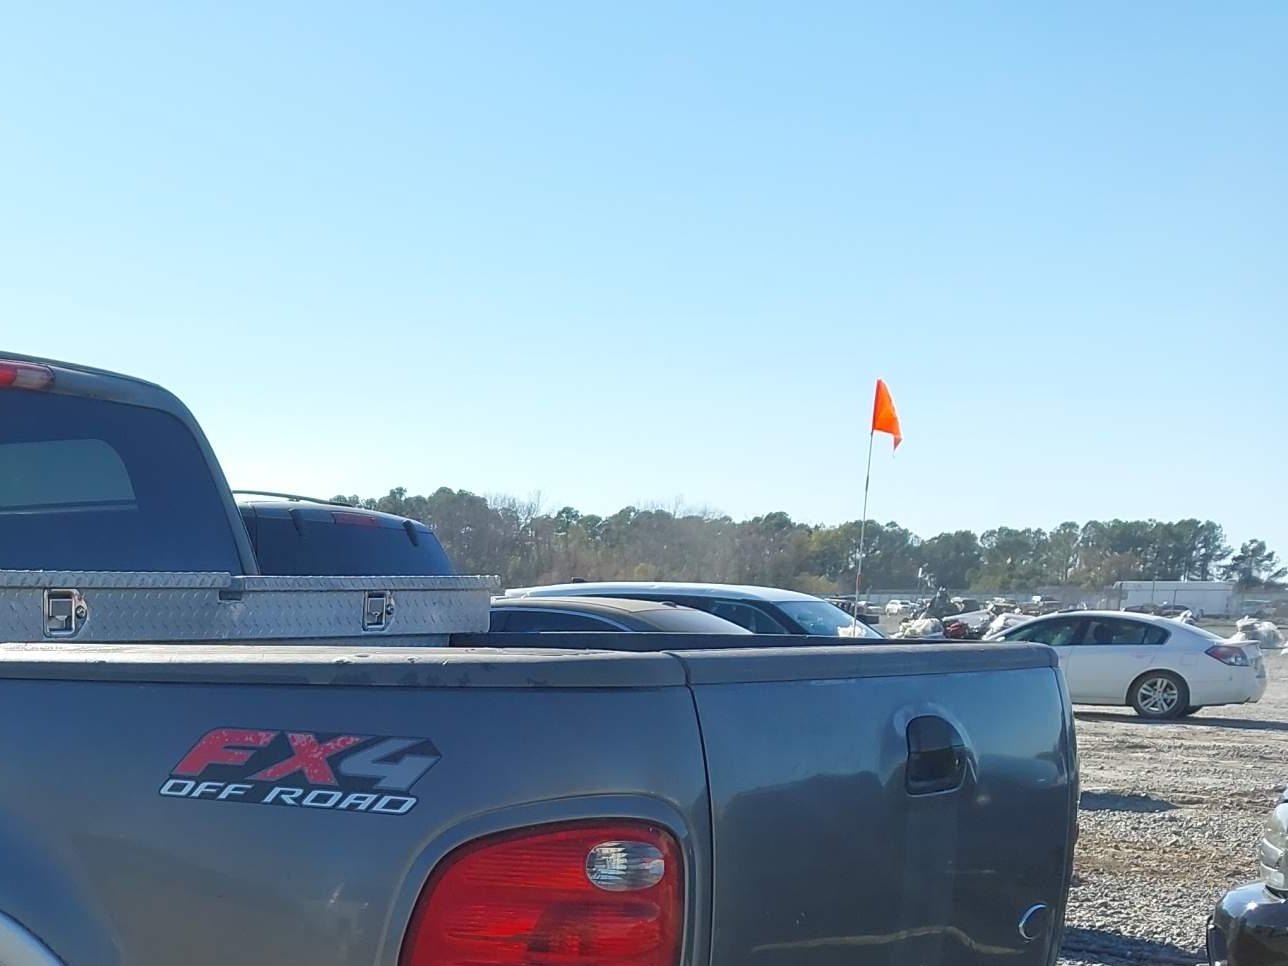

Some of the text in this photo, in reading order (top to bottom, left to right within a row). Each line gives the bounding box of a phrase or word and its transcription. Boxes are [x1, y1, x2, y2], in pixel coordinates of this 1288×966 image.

[170, 727, 442, 792] FX4
[160, 778, 418, 815] OFF ROAD
